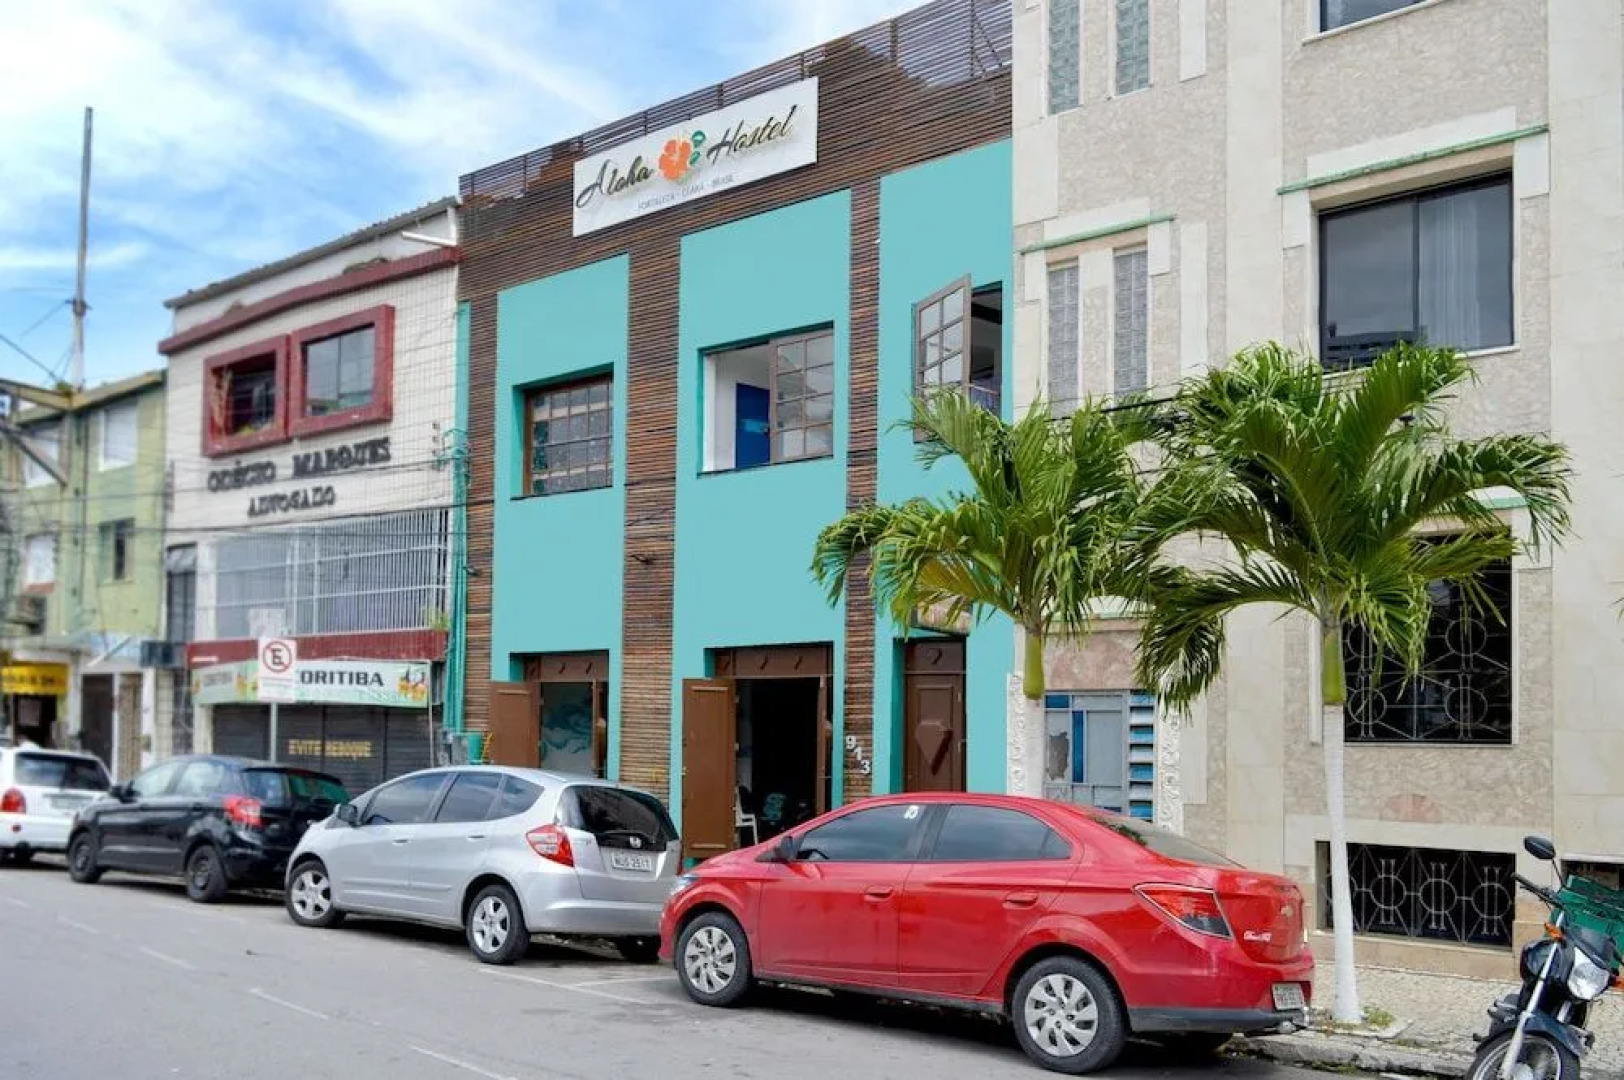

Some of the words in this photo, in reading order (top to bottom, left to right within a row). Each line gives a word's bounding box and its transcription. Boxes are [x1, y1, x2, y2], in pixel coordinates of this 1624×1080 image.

[577, 155, 654, 208] Aloha
[706, 104, 797, 165] Hostel
[292, 436, 391, 479] MARQUES
[247, 485, 335, 517] ADVOGADO
[298, 670, 384, 687] ORITIBA
[288, 739, 321, 756] EVITE
